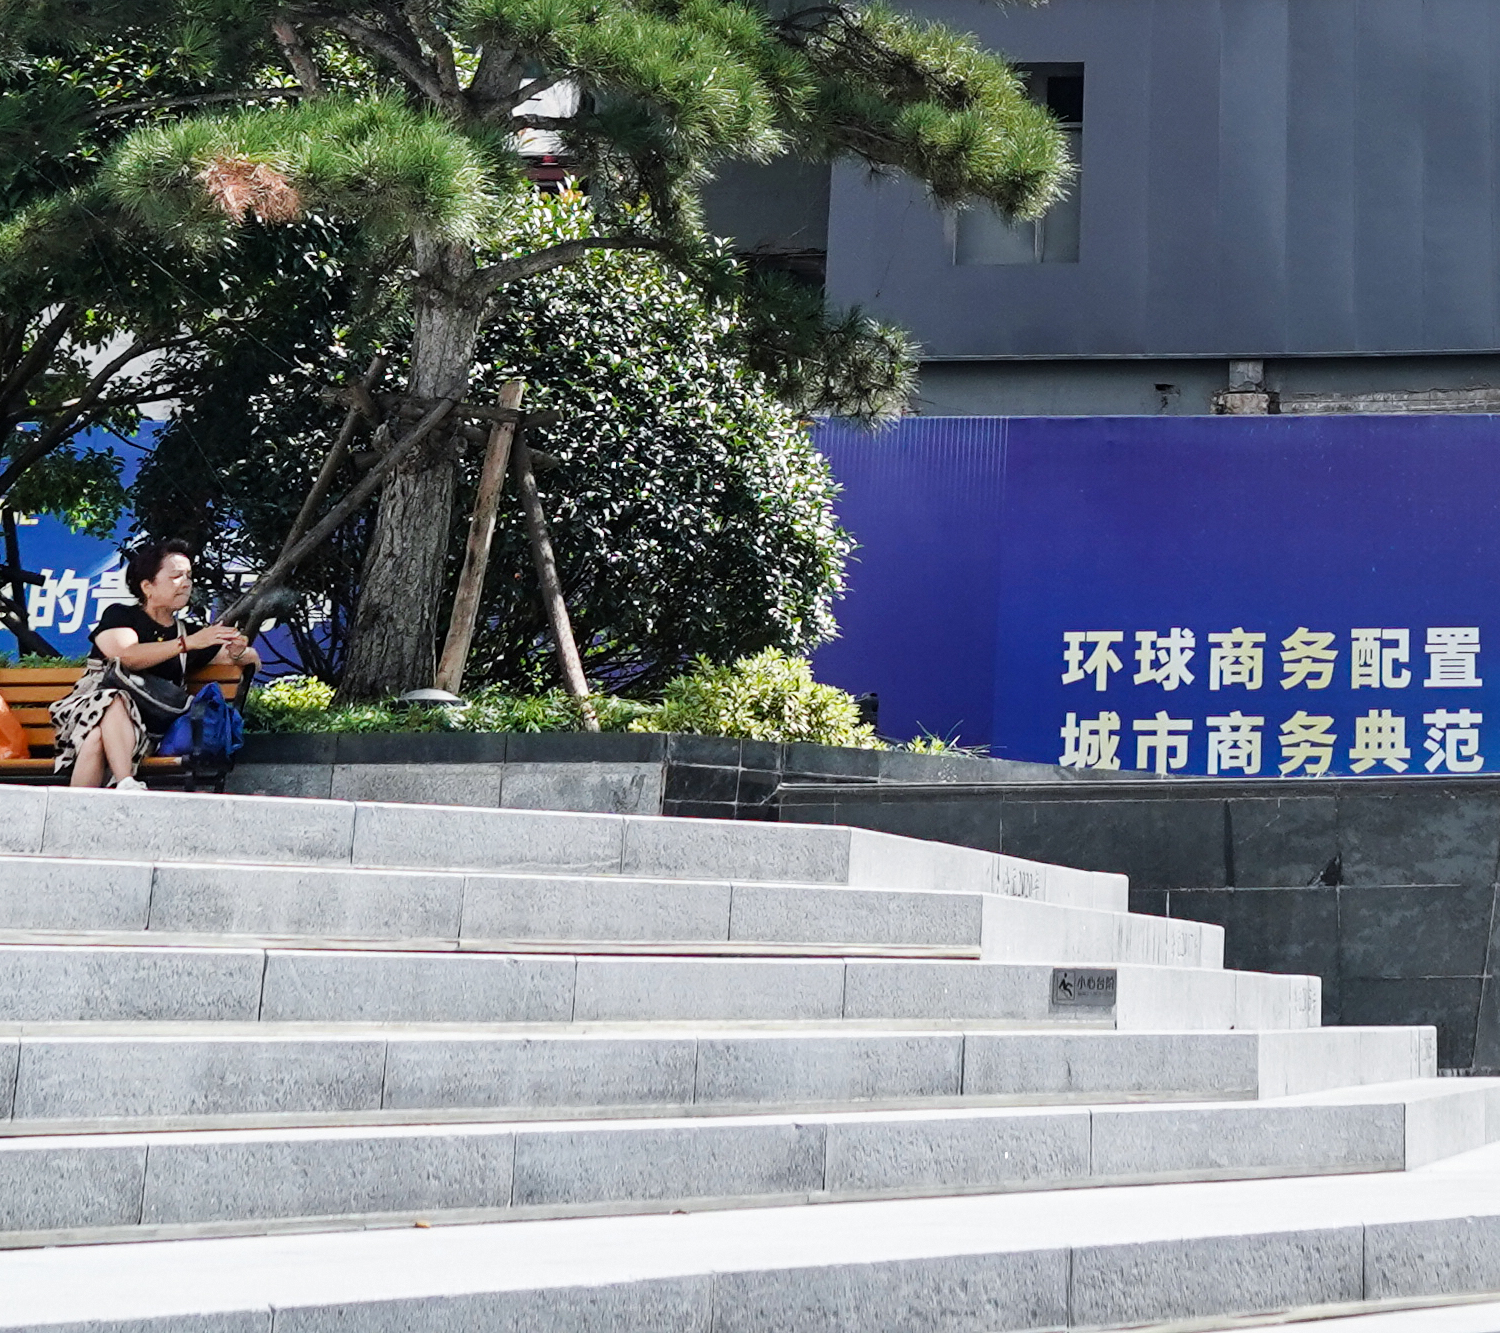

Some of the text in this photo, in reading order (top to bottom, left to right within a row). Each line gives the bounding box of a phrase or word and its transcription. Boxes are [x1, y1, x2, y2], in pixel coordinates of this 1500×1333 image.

[1061, 626, 1484, 691] 环球商务配置
[1058, 708, 1486, 775] 城市商务典范
[1077, 975, 1115, 990] 小心台阶
